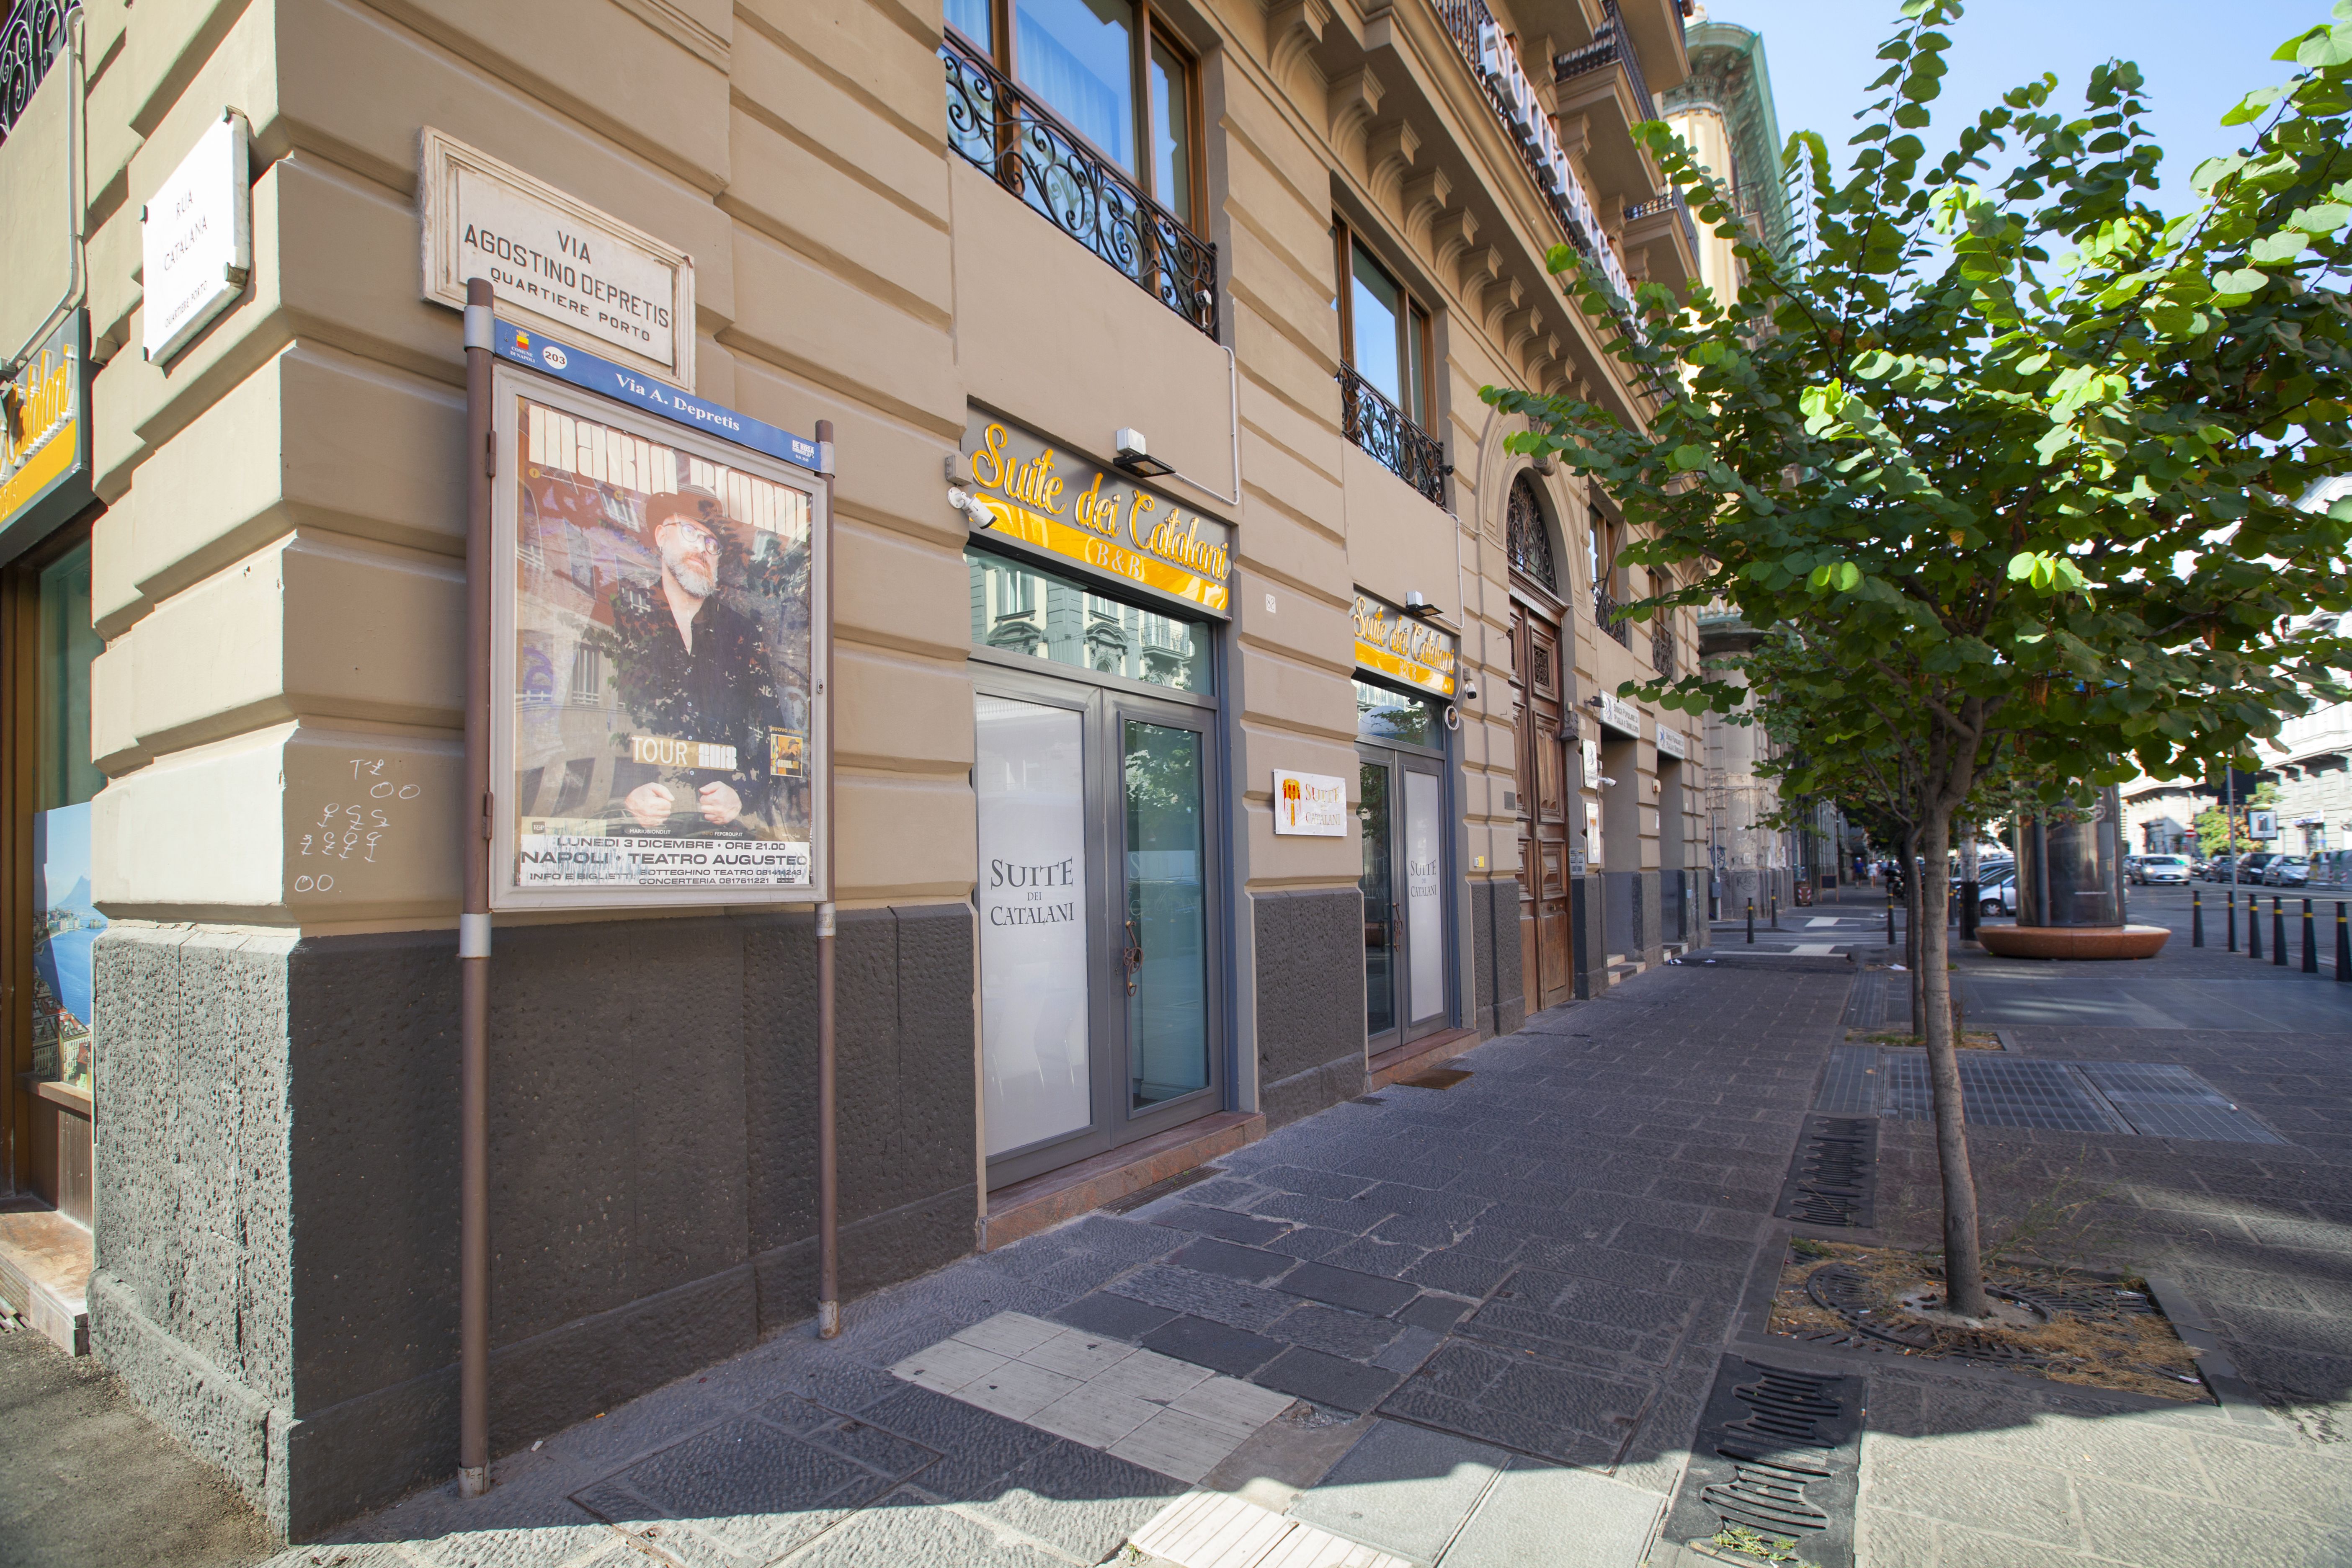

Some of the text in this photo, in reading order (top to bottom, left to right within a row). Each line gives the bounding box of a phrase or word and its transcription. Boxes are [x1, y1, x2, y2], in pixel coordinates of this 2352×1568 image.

[176, 189, 193, 219] RUA
[164, 214, 207, 271] CATALANA
[557, 230, 591, 264] VIA
[464, 224, 669, 328] AGOSTINO DEPRETIS
[165, 280, 208, 328] QUARTIERE PORTO
[490, 267, 650, 342] QUARTIERE PORTO
[511, 346, 534, 357] COMUNE
[516, 353, 535, 363] NAPOLI
[544, 351, 566, 365] 203
[616, 373, 740, 431] Via A. Depretis
[792, 441, 799, 449] DE
[800, 443, 814, 454] ROSA
[970, 423, 1230, 581] Suite dei Catalani
[1266, 596, 1275, 610] 82
[1351, 596, 1455, 675] Suite dei Catalani
[631, 737, 737, 769] TOUR 2018
[1305, 784, 1340, 804] SUITE
[1305, 812, 1341, 826] CATALANI
[638, 840, 714, 849] DICEMBRE
[521, 851, 808, 865] NAPOLI TEATRO AUGUSTEO
[1410, 858, 1436, 877] SUITE
[990, 856, 1073, 890] SUITE
[1027, 892, 1042, 901] DEI
[1411, 884, 1437, 897] CATALANI
[990, 902, 1074, 926] CATALANI
